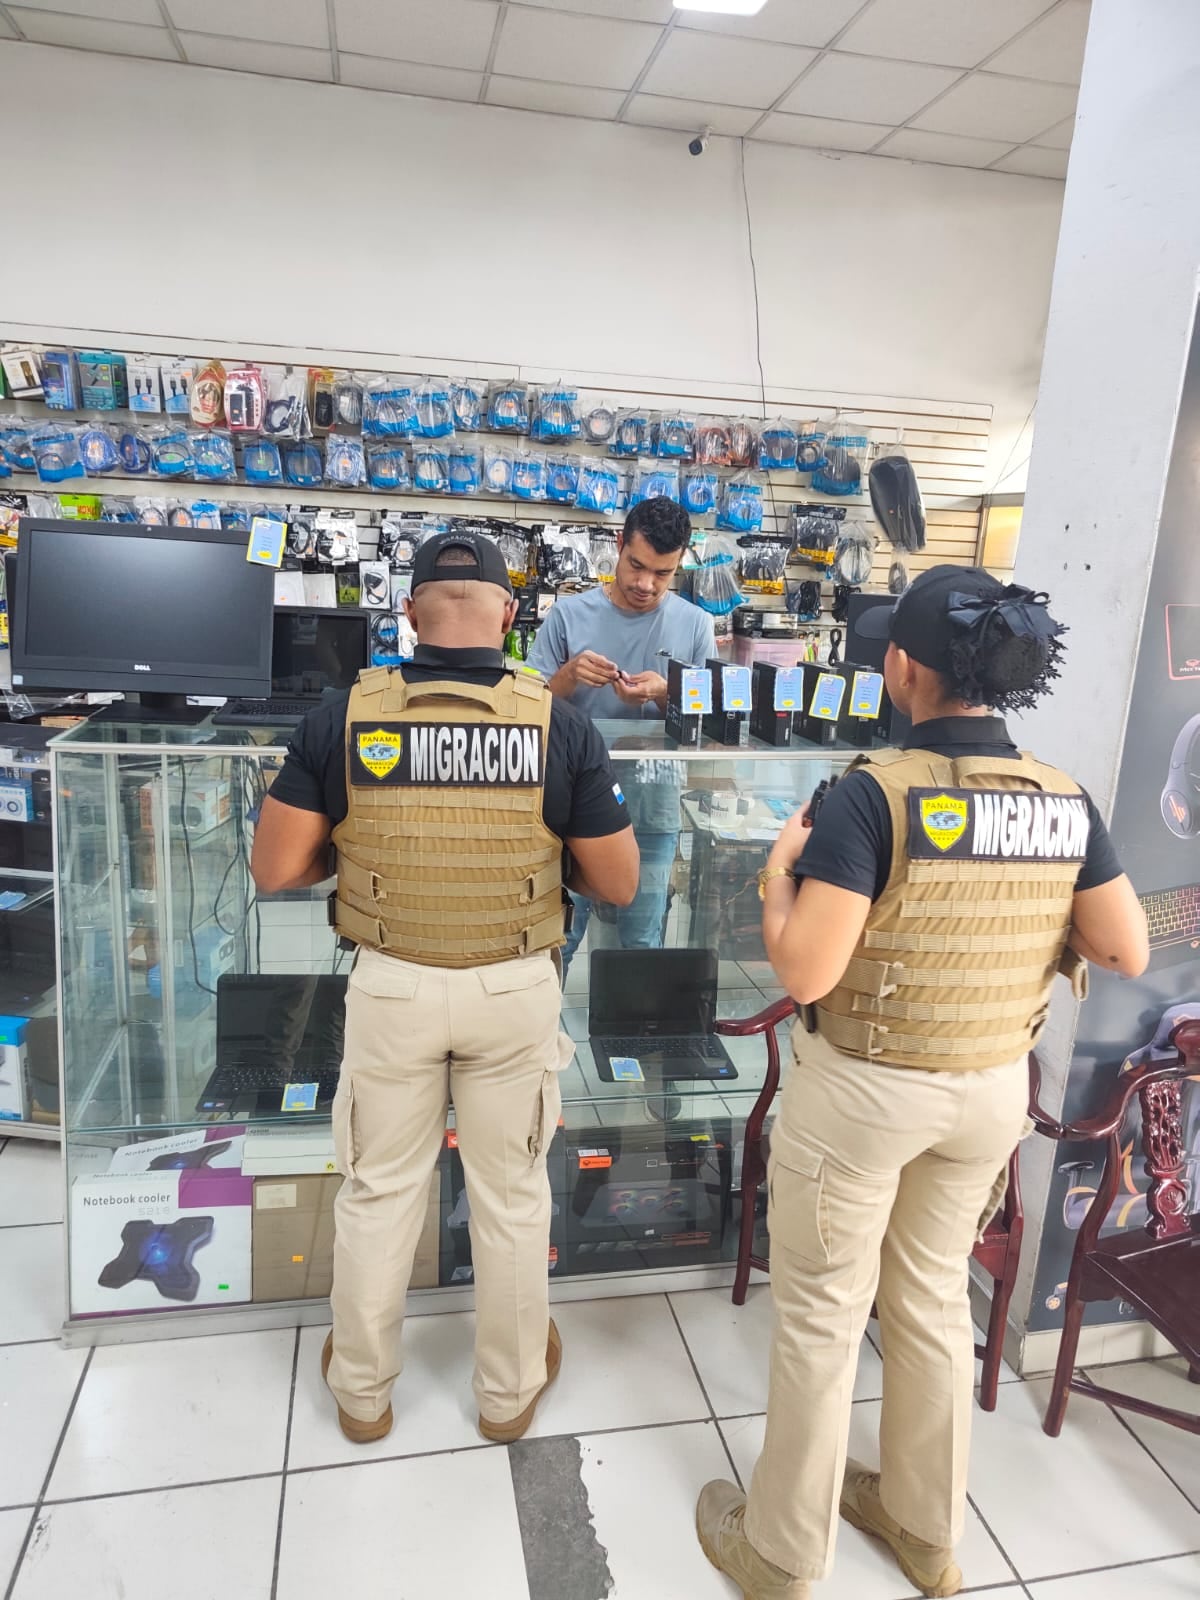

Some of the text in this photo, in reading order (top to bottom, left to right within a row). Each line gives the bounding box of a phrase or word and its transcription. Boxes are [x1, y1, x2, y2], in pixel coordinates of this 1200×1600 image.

[410, 727, 539, 782] MIGRACION
[972, 794, 1090, 858] MIGRACION
[124, 1145, 168, 1157] Notebook
[83, 1192, 171, 1206] Notebook cooler
